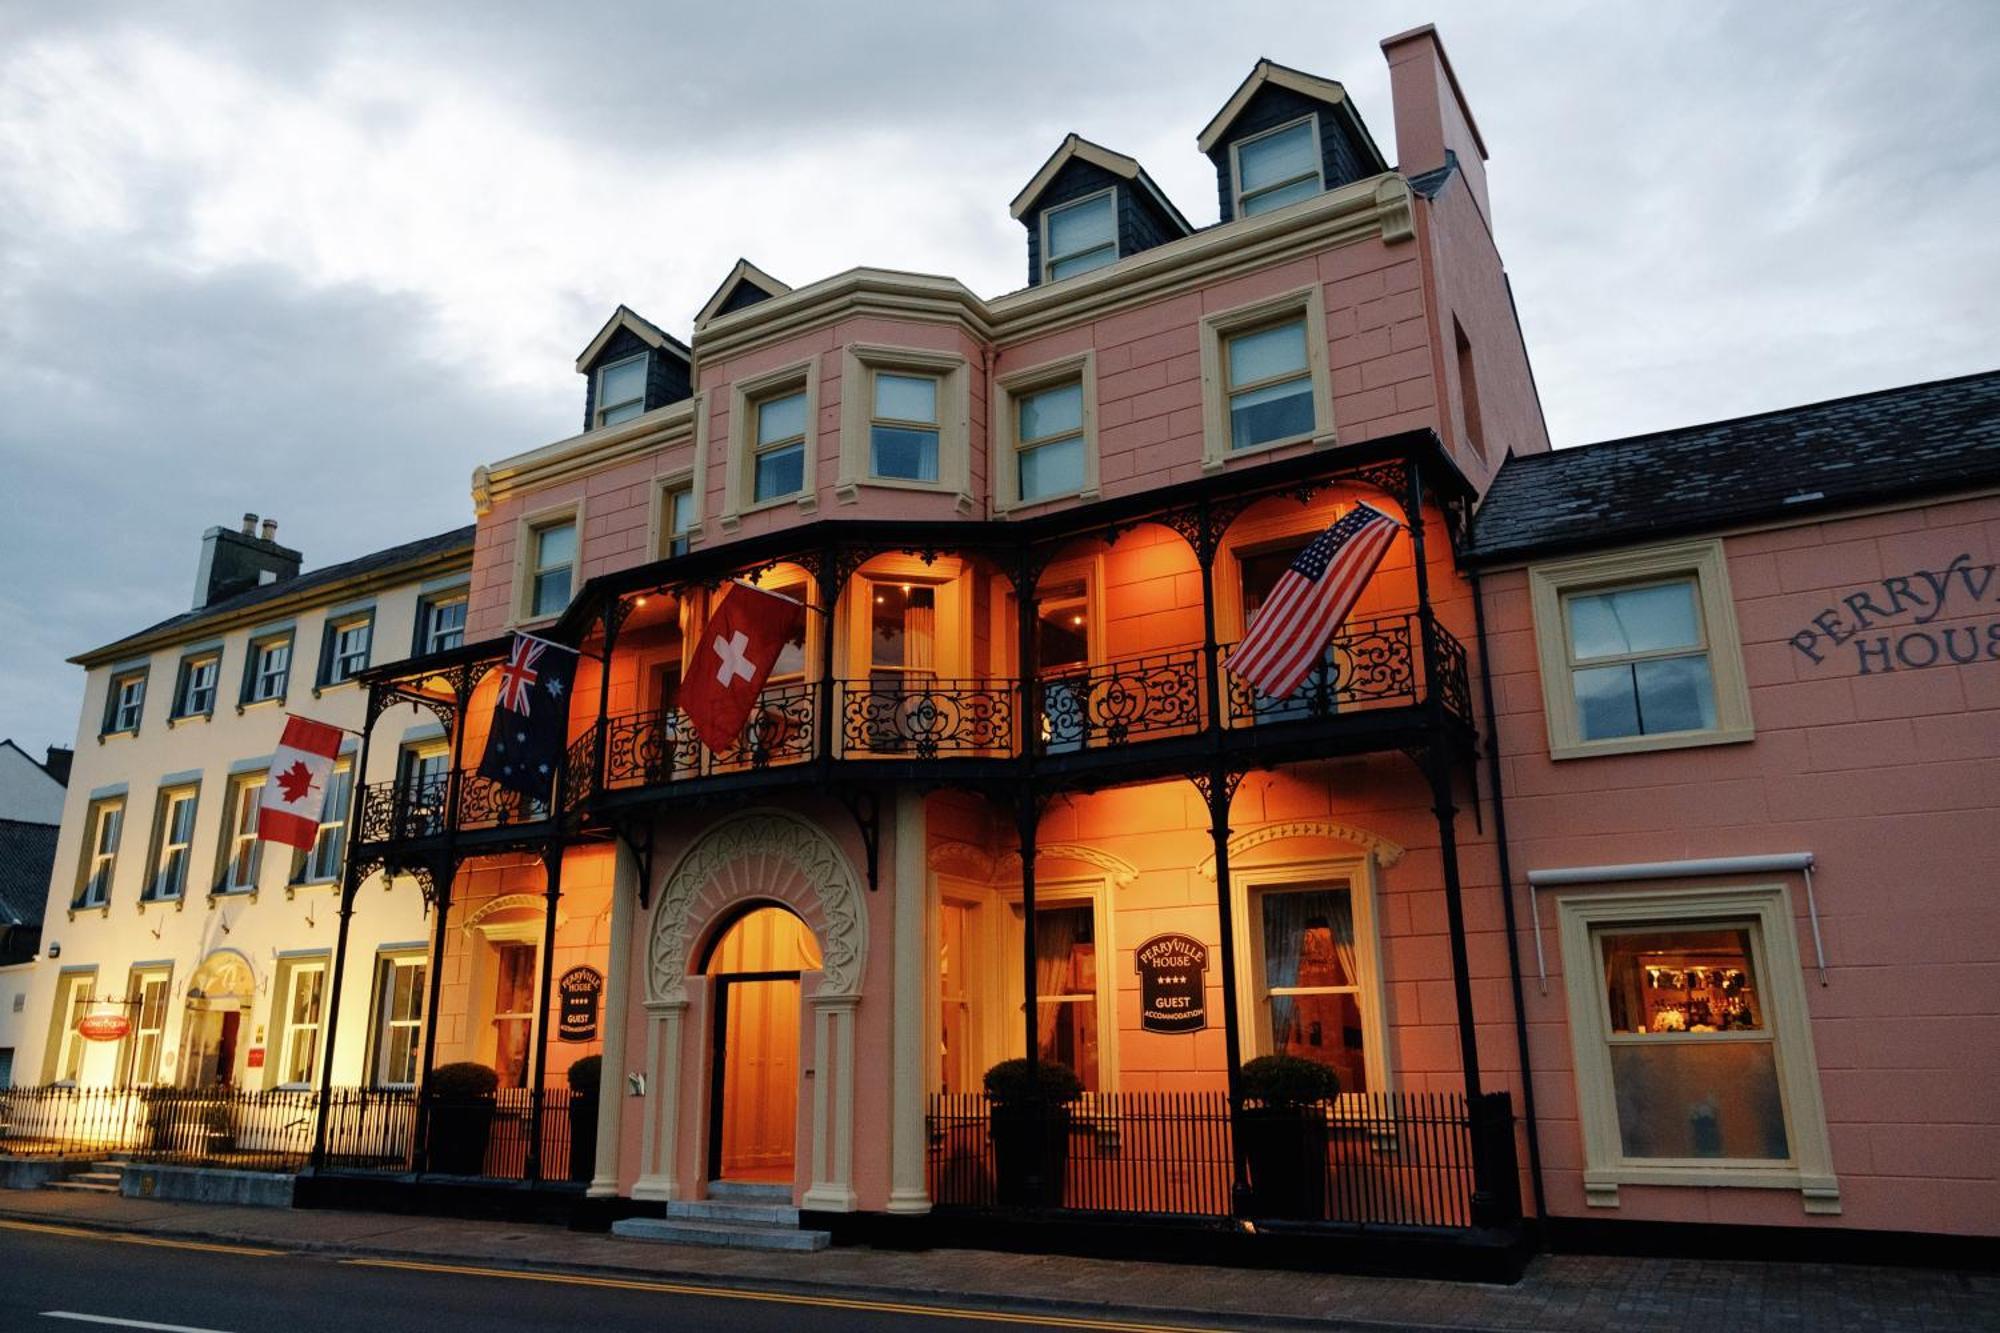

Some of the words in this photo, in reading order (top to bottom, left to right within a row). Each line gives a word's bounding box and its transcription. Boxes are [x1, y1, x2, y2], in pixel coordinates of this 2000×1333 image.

[1789, 553, 2000, 665] PERRYV
[1140, 938, 1204, 964] PERRYVILLE
[1152, 956, 1191, 968] HOUSE
[1155, 997, 1191, 1008] GUEST
[567, 1014, 589, 1024] GUEST
